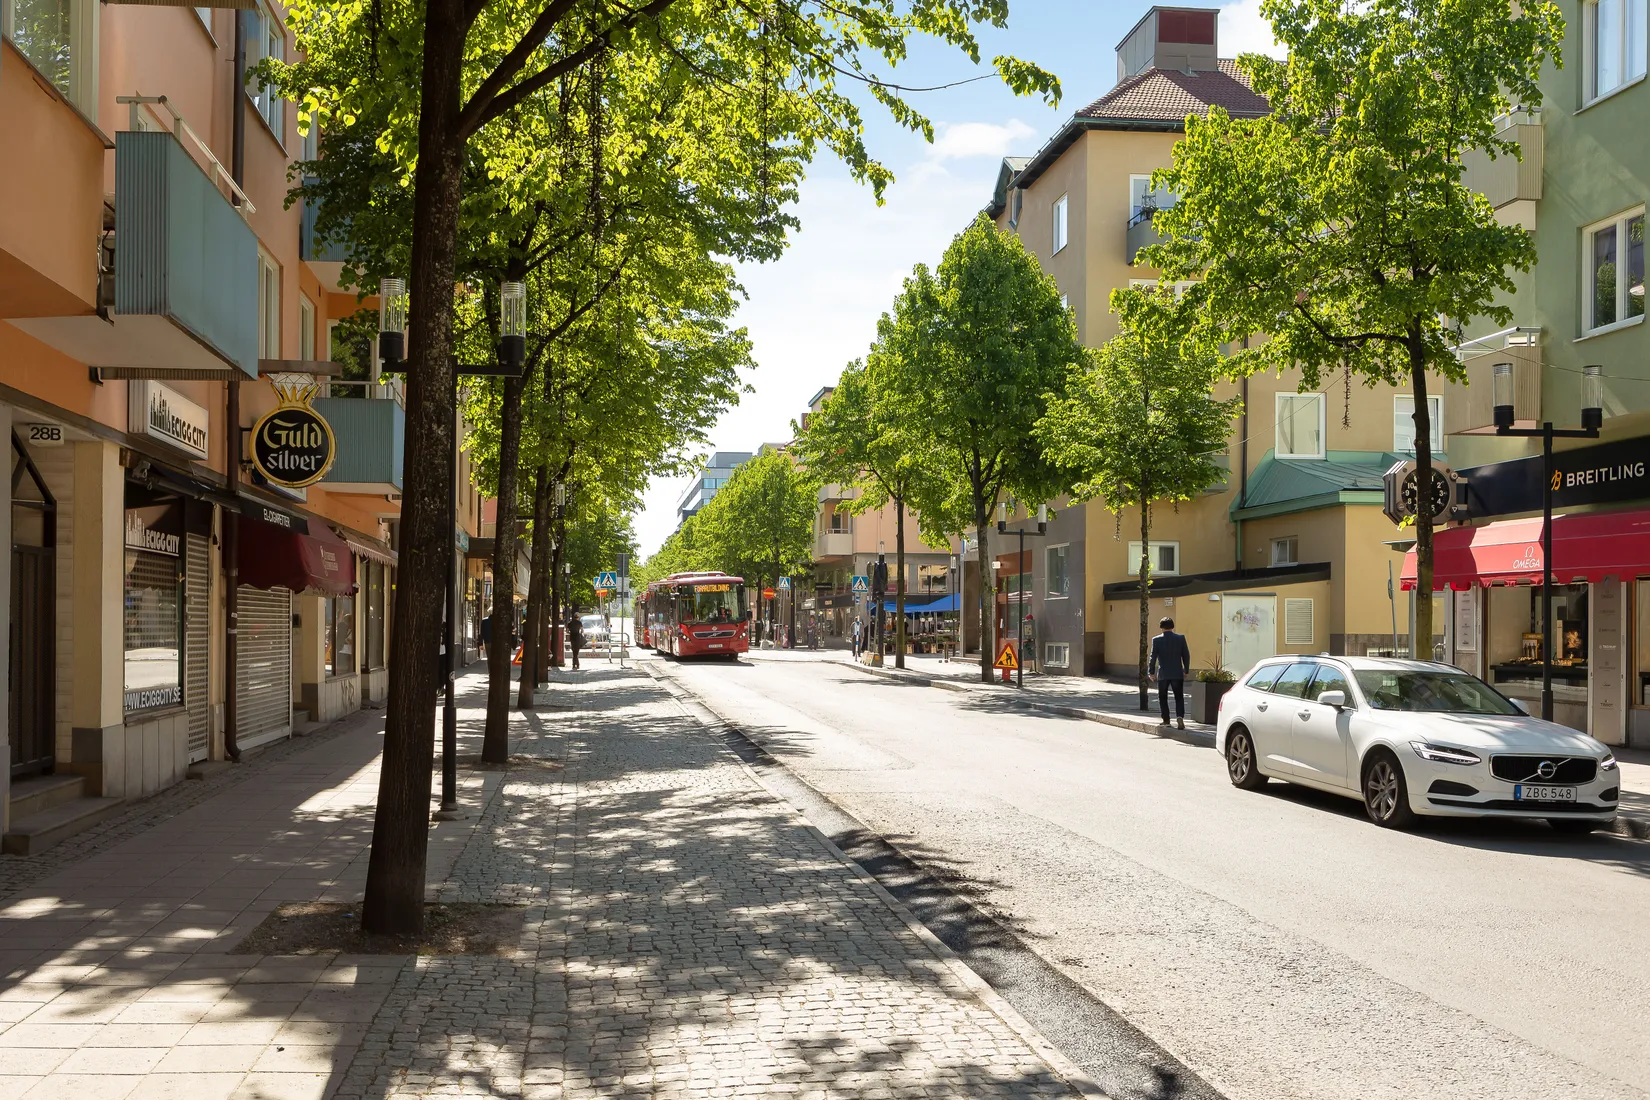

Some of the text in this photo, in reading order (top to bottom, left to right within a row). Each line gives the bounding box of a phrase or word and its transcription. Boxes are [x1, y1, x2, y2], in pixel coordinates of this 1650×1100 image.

[30, 426, 62, 440] 28B
[171, 415, 206, 449] ECIGG CITY
[263, 418, 322, 448] Guld
[266, 450, 322, 470] silver
[1566, 462, 1644, 487] BREITLING
[146, 529, 180, 553] ECIGG CITY
[1512, 559, 1540, 568] OMEGA
[1526, 788, 1572, 799] ZBG 548
